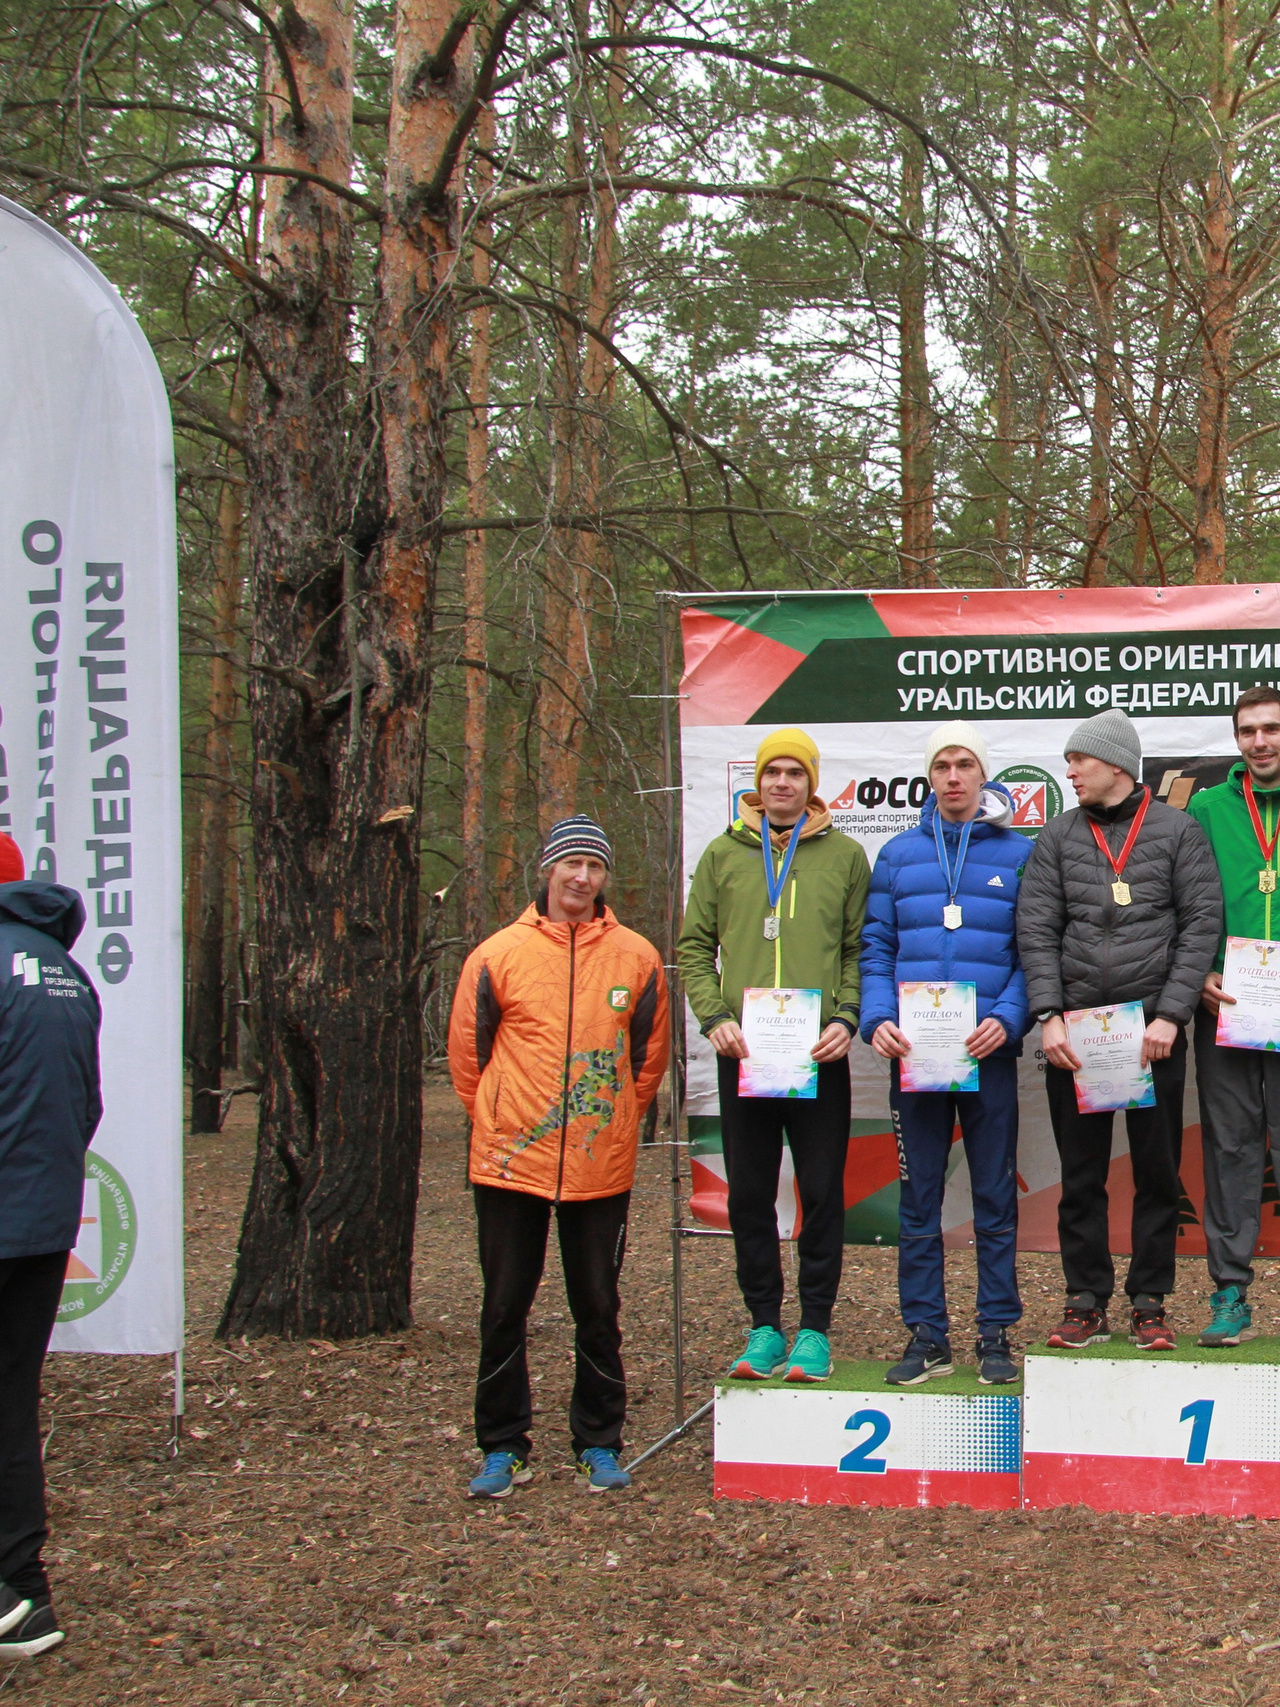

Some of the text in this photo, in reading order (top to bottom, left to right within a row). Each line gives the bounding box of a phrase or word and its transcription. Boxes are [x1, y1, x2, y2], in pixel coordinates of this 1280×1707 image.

[897, 647, 1111, 675] СПОРТИВНОЕ
[897, 679, 1076, 711] УРАЛЬСКИЙ
[1008, 768, 1048, 781] СПОРТИВНОГО
[856, 777, 931, 809] ФСО
[831, 813, 922, 825] дерация спортив
[756, 1016, 806, 1025] ДИПЛОМ
[911, 1011, 962, 1019] ДИПЛОМ
[1082, 1032, 1133, 1046] ДИПЛОМ
[839, 1408, 891, 1473] 2
[1179, 1399, 1215, 1463] 1
